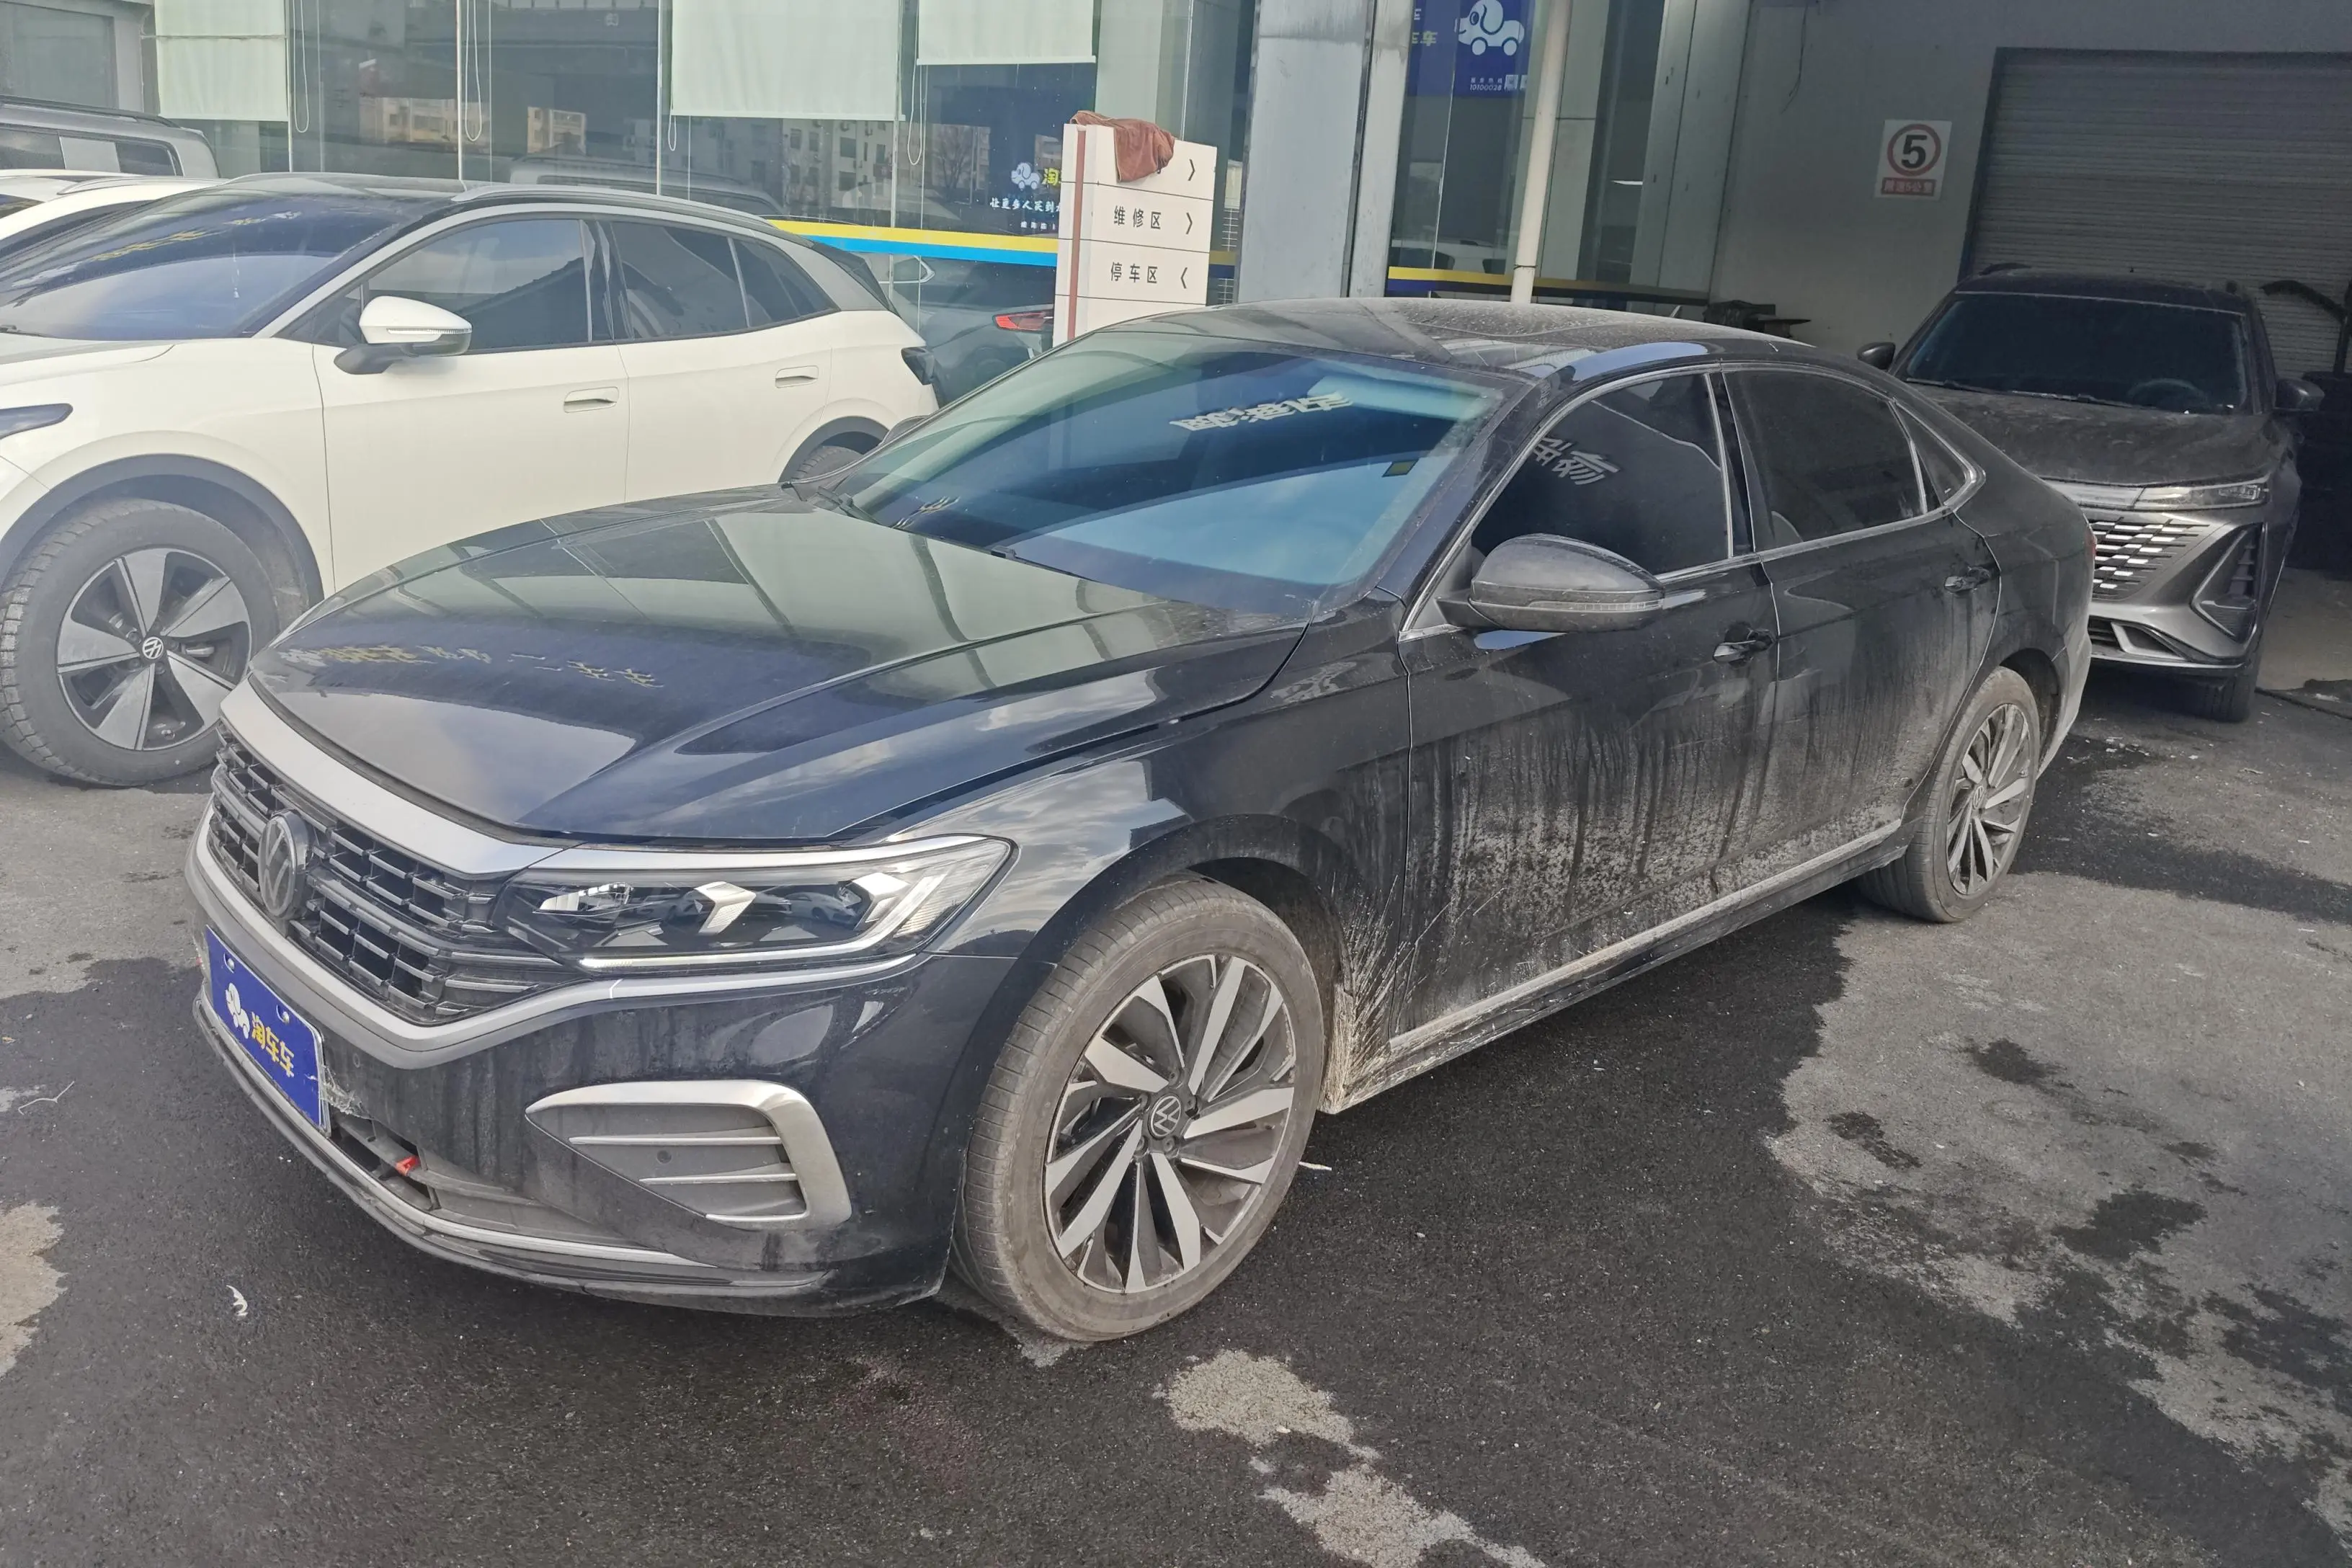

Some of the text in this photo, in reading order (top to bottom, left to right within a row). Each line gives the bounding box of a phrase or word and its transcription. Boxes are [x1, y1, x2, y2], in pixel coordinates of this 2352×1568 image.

[1901, 135, 1928, 169] 5
[1113, 205, 1162, 230] 维修区
[1110, 262, 1158, 284] 停车区
[251, 1011, 295, 1077] 淘车车
